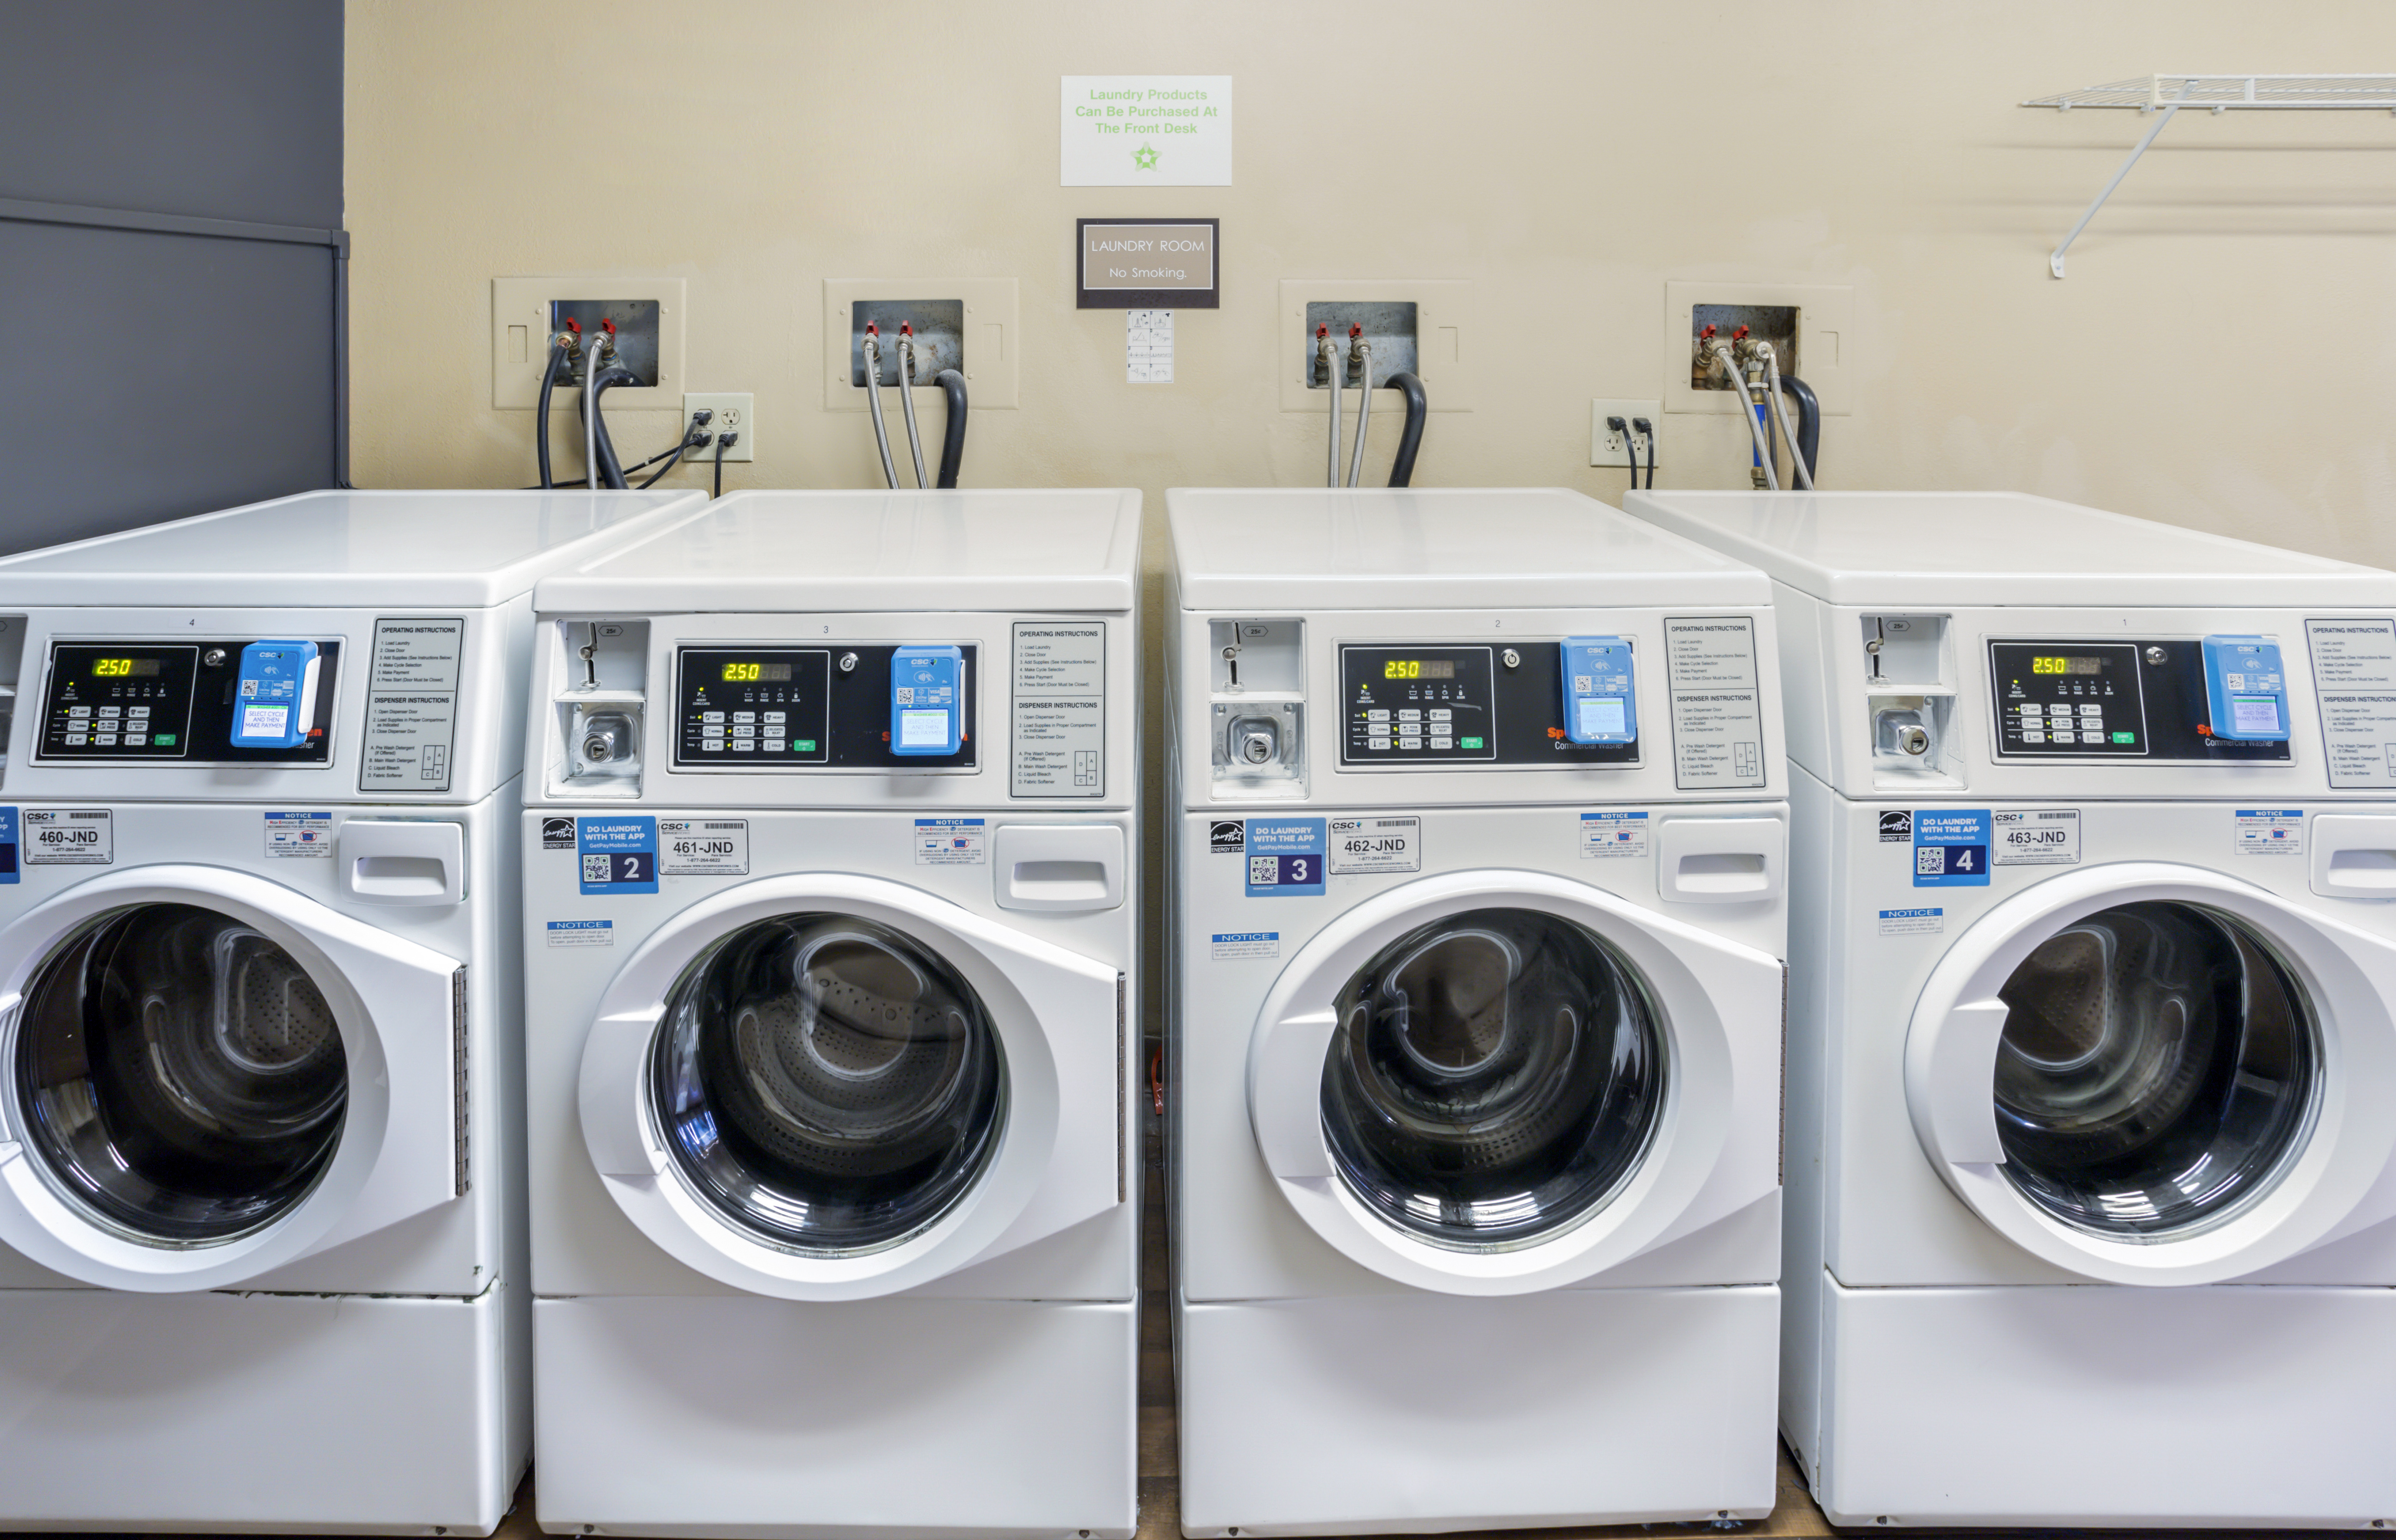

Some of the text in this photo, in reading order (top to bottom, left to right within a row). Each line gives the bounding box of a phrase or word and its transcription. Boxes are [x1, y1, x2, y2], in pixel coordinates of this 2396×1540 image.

[1090, 89, 1207, 101] Laundry Products
[1076, 106, 1217, 117] Can Be Purchased At
[1095, 123, 1197, 133] The Front Desk
[1092, 240, 1204, 251] LAUNDRY ROOM
[1110, 268, 1186, 280] No Smoking.
[96, 659, 131, 675] 2.50
[725, 664, 760, 679] 2.50
[1385, 662, 1420, 677] 2.50
[2033, 658, 2065, 673] 2.50
[39, 831, 98, 842] 460-JND
[2007, 832, 2065, 843] 463-JND
[673, 842, 733, 853] 461-JND
[1345, 840, 1405, 852] 462-JND
[1956, 850, 1973, 870] 4
[624, 857, 639, 878] 2
[1292, 859, 1307, 880] 3
